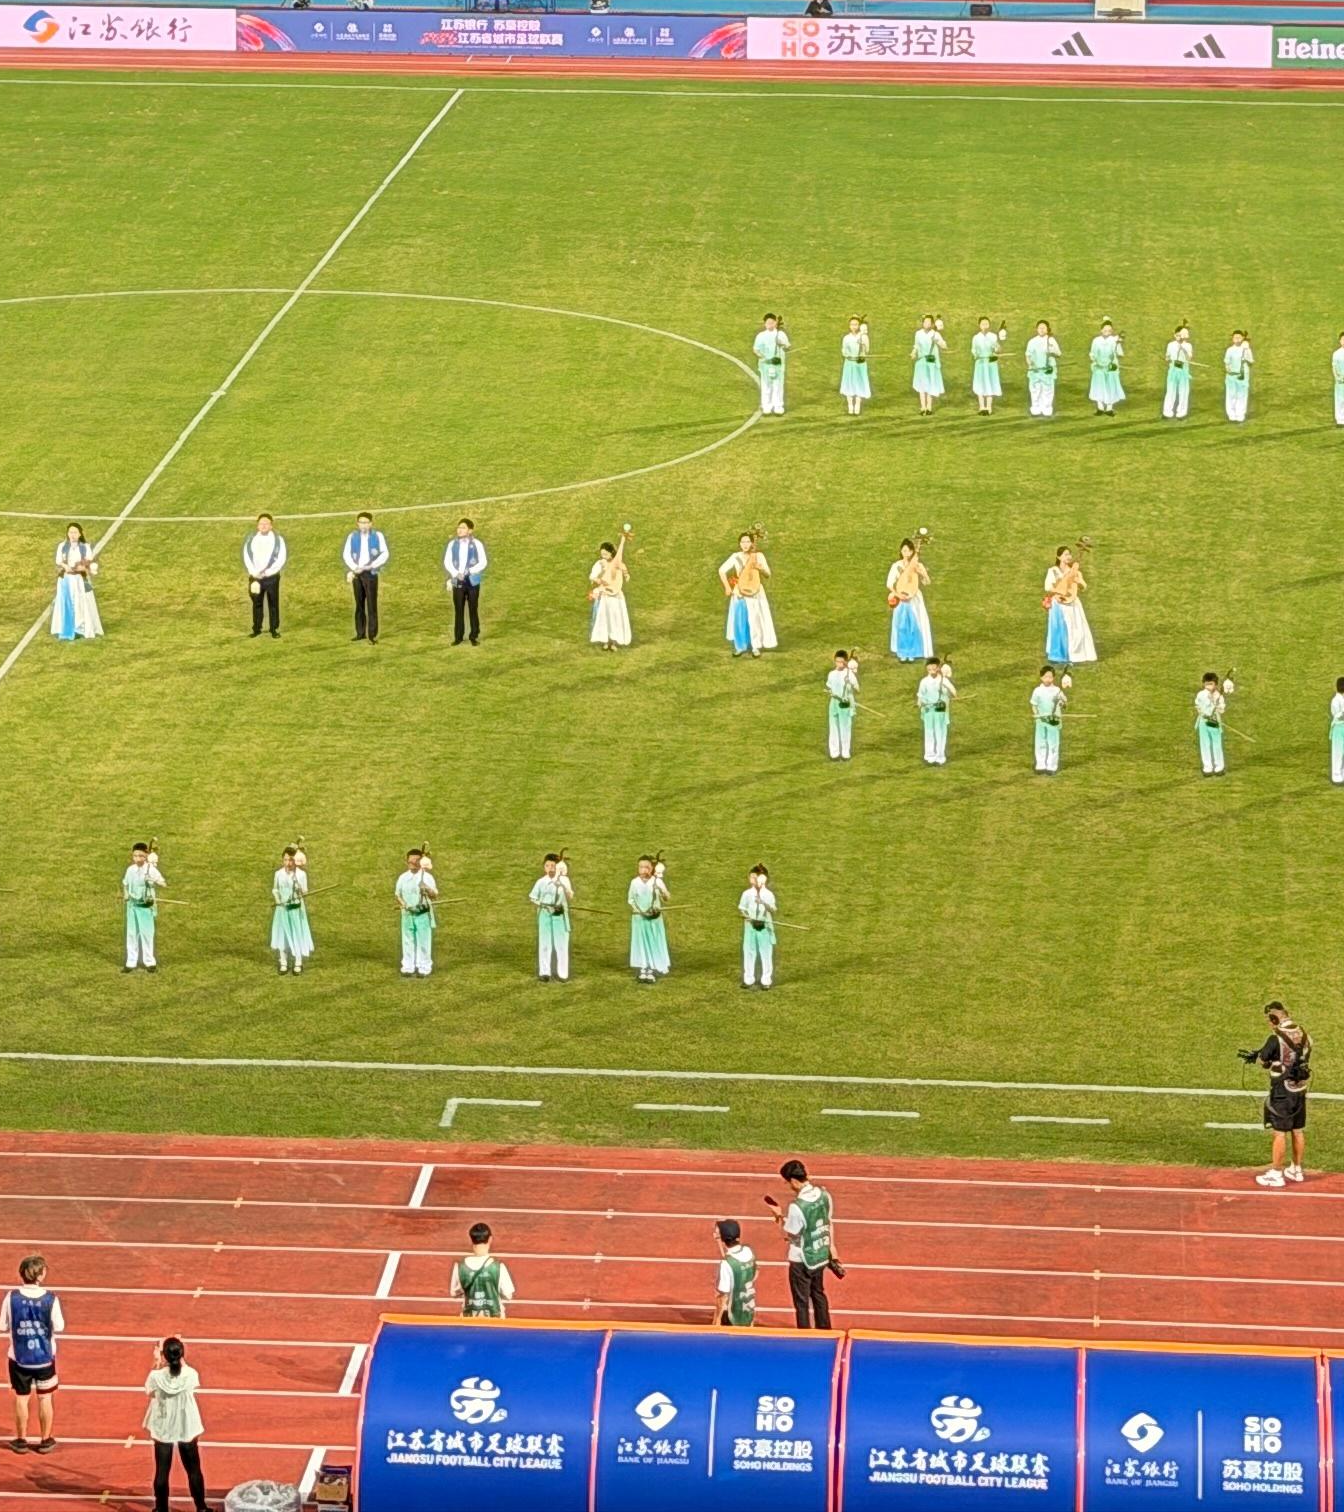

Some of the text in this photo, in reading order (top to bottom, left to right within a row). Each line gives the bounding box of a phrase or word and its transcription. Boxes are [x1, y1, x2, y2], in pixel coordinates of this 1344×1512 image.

[69, 14, 192, 43] 江苏银行
[827, 25, 976, 58] 苏豪控股
[387, 1429, 565, 1457] 江苏省城市足球联赛
[617, 1436, 690, 1457] 江苏银行
[733, 1438, 813, 1460] 苏豪控股
[386, 1453, 562, 1469] JIANGSU FOOTBALL CITY LEAGUE
[733, 1460, 813, 1472] SOHO HOLDINGS
[869, 1448, 1050, 1477] 江苏省城市足球联赛
[1105, 1457, 1179, 1479] 江苏银行
[1222, 1459, 1304, 1482] 苏豪控股
[869, 1472, 1048, 1490] JIANGSU FOOTBALL CITY LEAGUE
[1222, 1481, 1304, 1494] SOHO HOLDINGS
